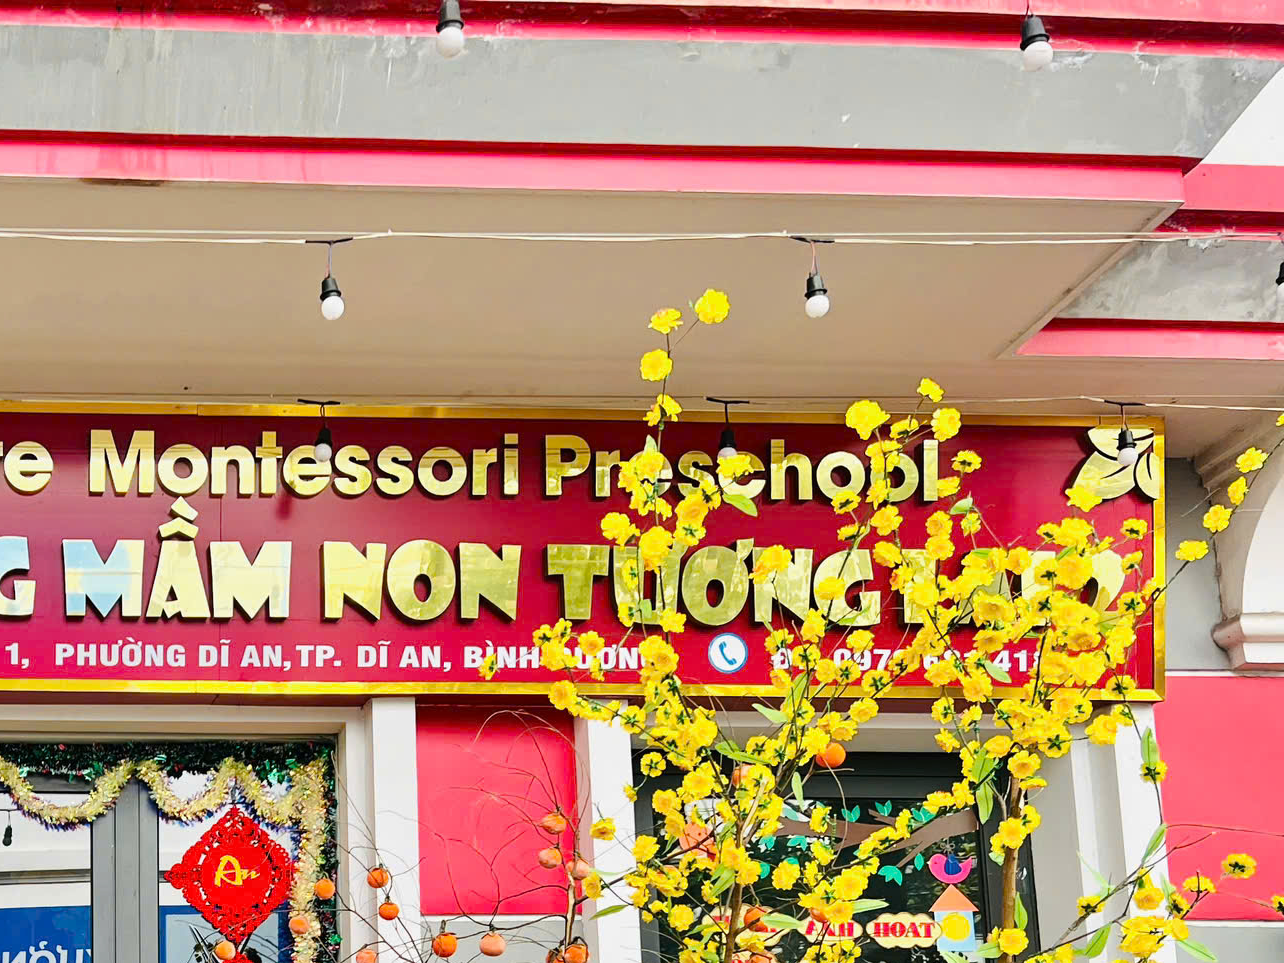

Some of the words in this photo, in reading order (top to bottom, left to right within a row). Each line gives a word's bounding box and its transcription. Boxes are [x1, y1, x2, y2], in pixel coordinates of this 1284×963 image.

[88, 428, 519, 497] Montessori
[63, 496, 292, 621] MẦM
[322, 539, 522, 622] NON
[4, 641, 30, 669] 1,
[54, 637, 186, 667] PHƯỜNG
[198, 639, 231, 667] DĨ
[357, 640, 391, 668] DĨ
[399, 645, 452, 672] AN,
